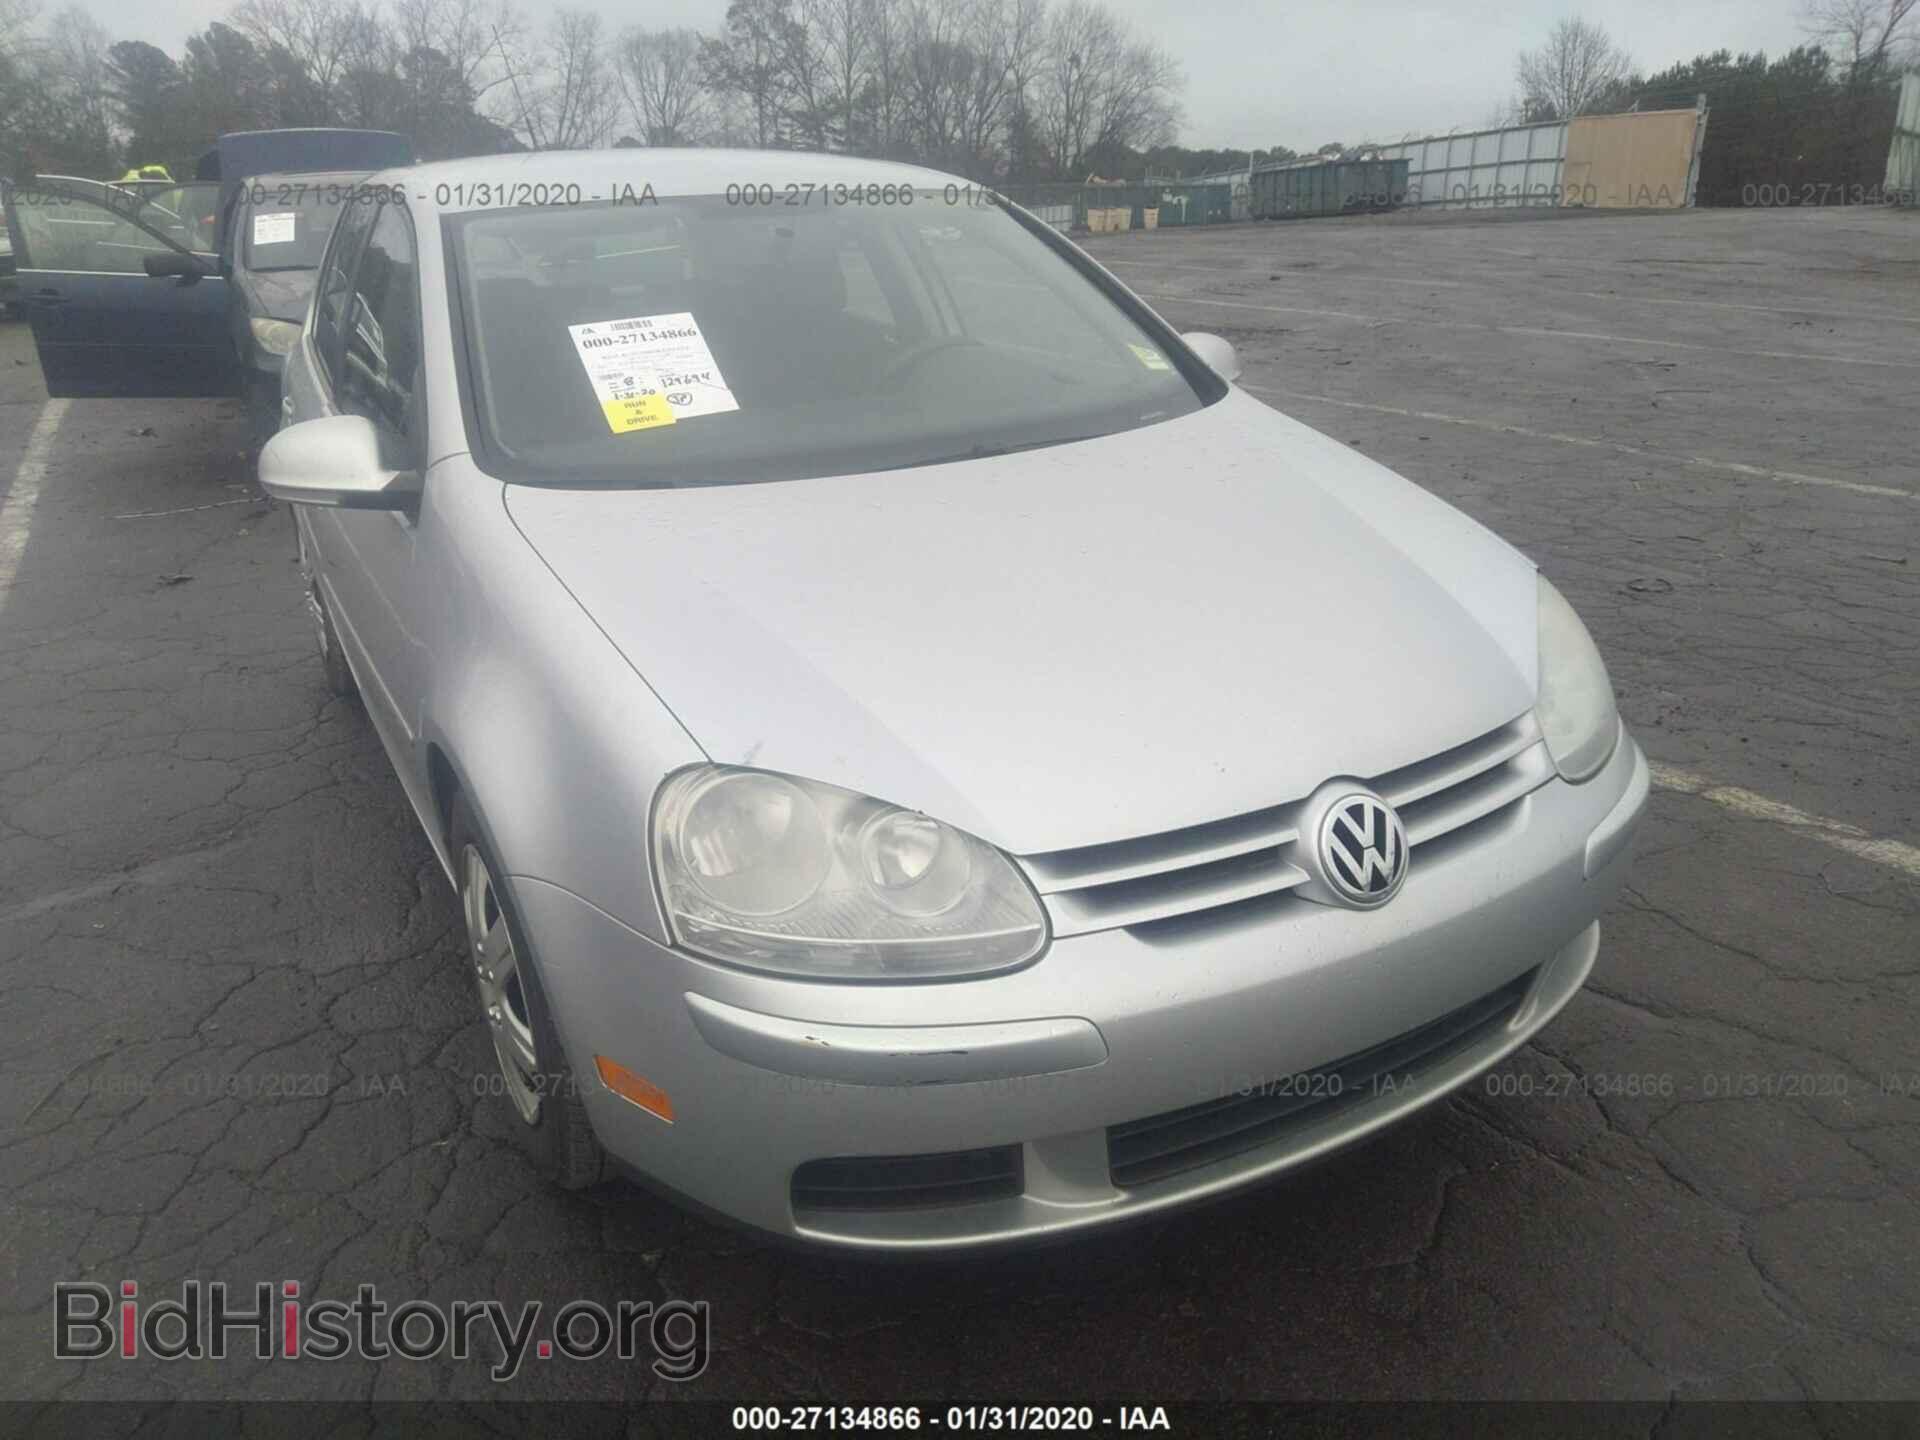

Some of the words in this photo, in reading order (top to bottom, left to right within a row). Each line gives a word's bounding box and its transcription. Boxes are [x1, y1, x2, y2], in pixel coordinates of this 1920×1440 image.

[582, 327, 697, 349] 000-27134866
[624, 400, 647, 409] RUN
[626, 415, 658, 425] DRIVE
